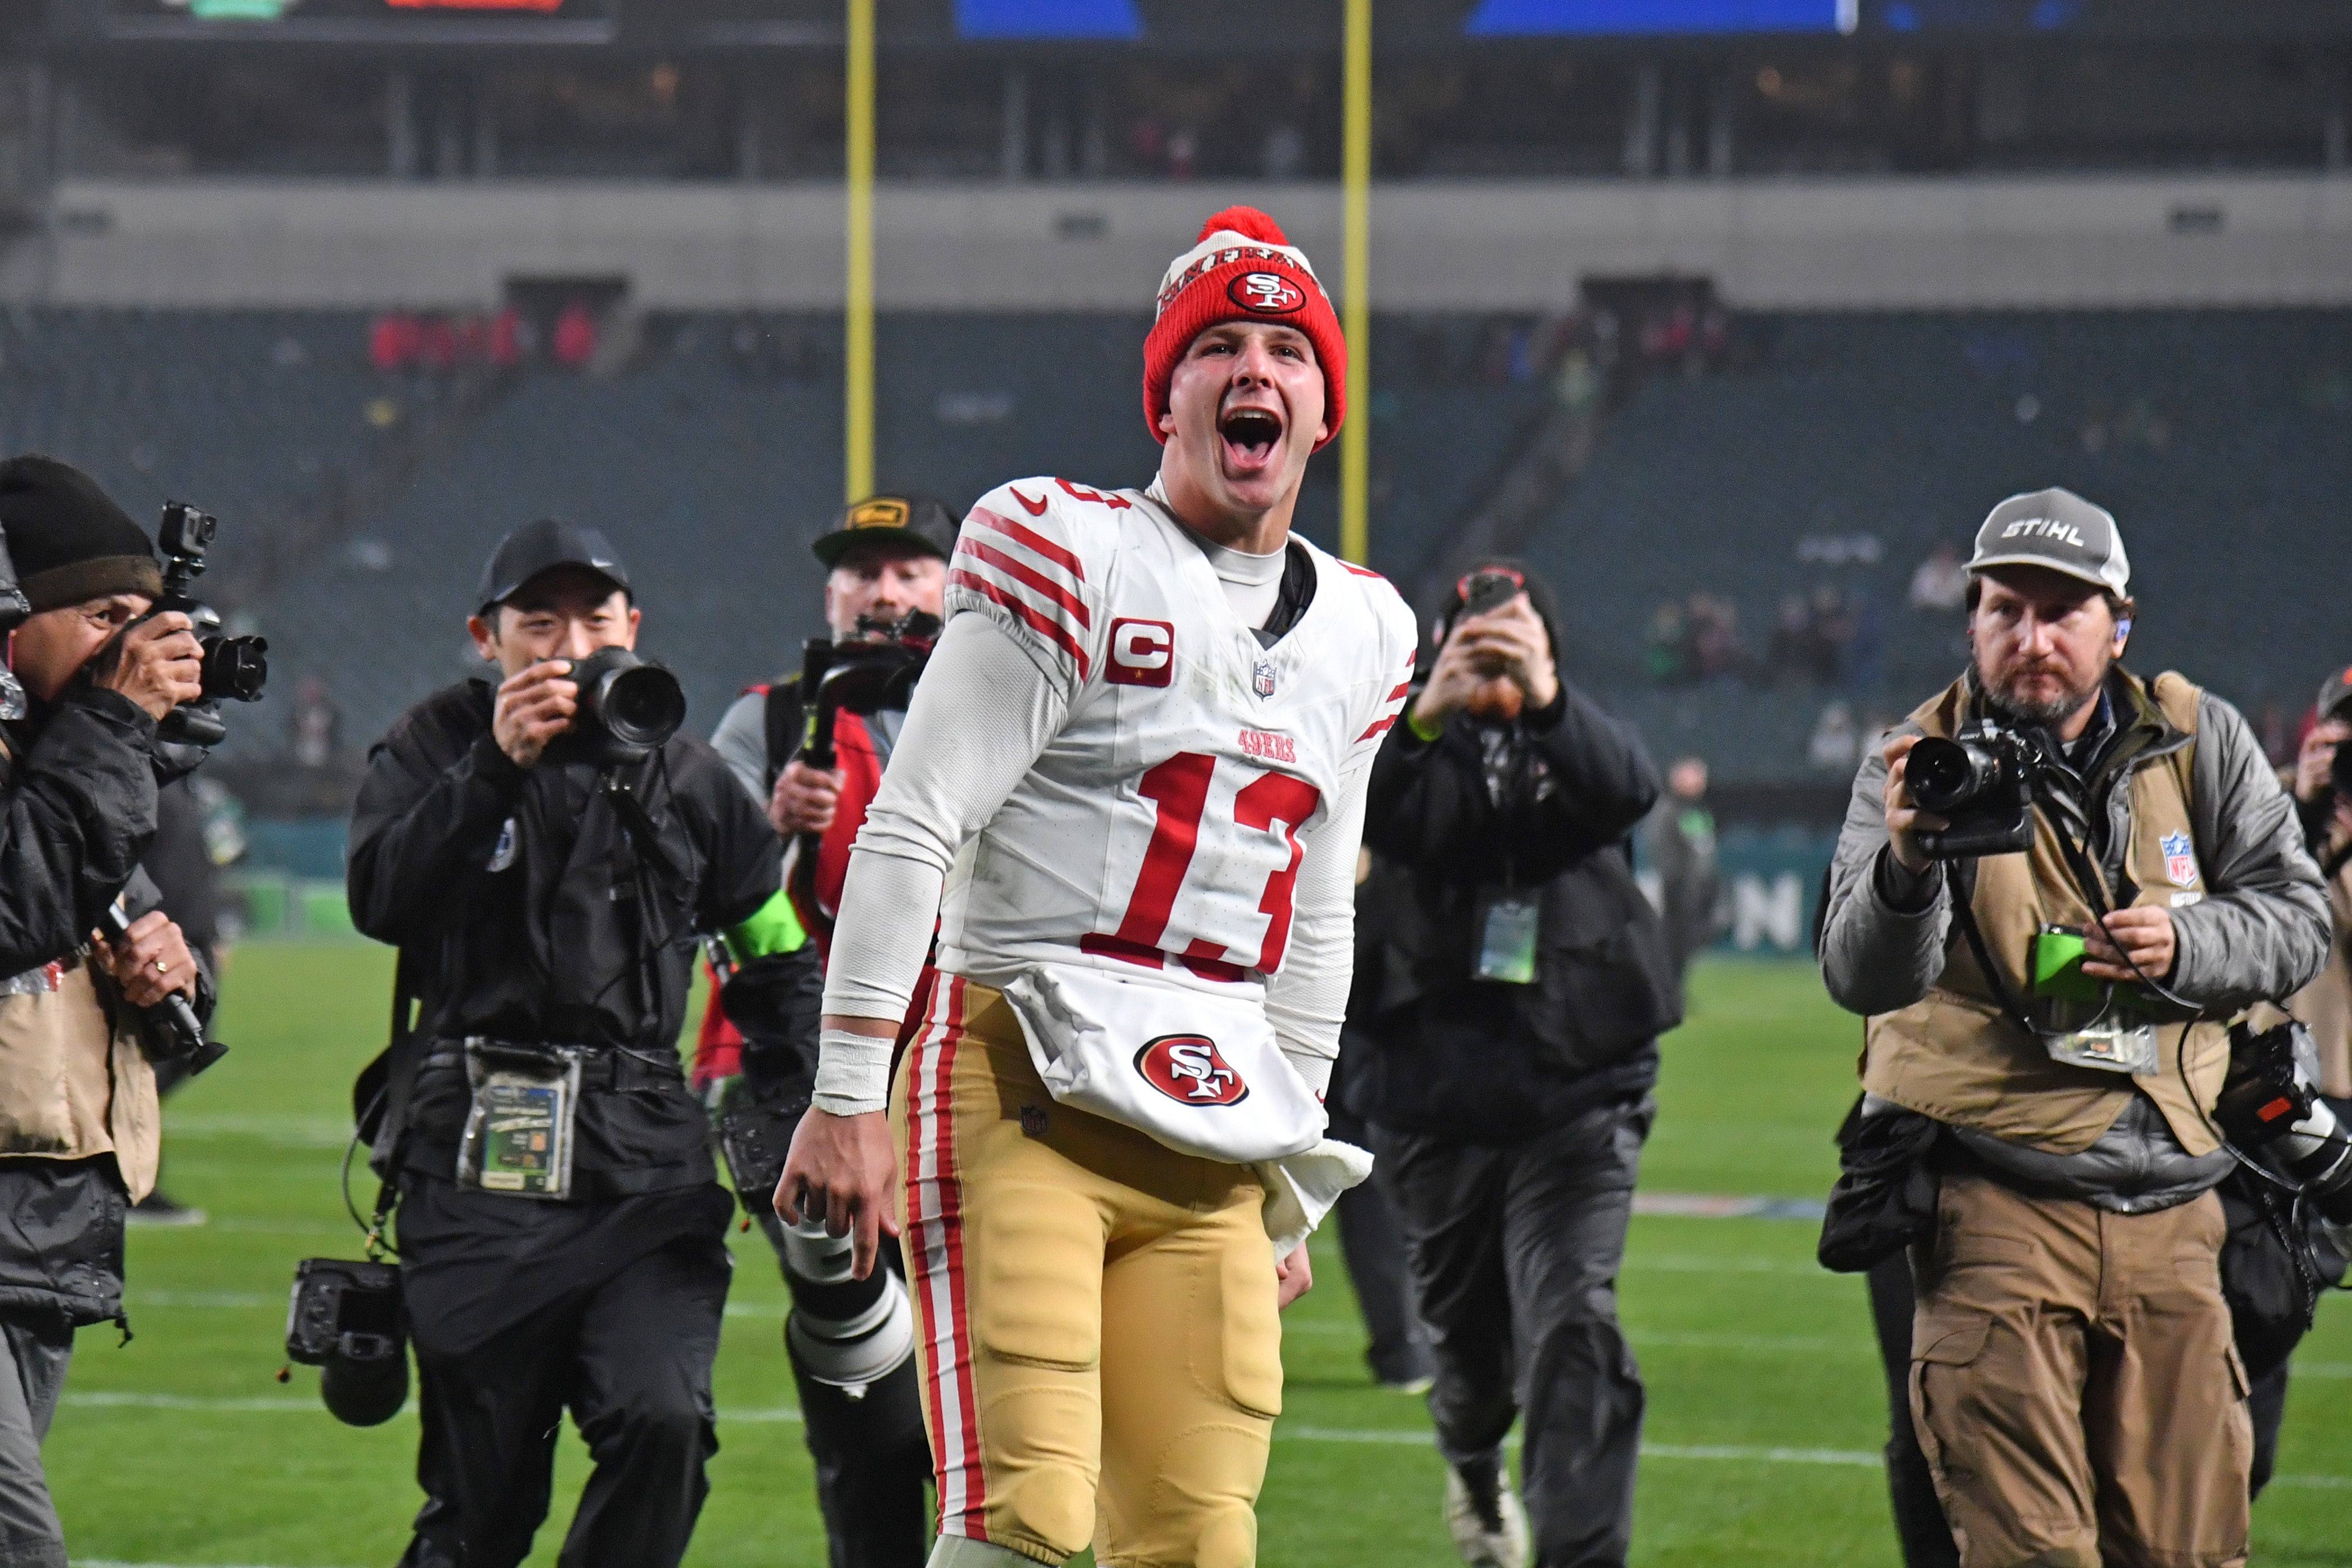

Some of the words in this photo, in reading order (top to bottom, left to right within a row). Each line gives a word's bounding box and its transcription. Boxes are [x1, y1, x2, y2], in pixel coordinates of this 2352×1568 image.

[1246, 274, 1297, 308] SF
[2000, 517, 2085, 547] STIHL
[1113, 622, 1170, 669] C
[1257, 676, 1274, 694] NFL
[1238, 729, 1297, 764] 49ERS
[1079, 751, 1321, 983] 13
[2168, 856, 2195, 882] NFL
[1168, 1045, 1234, 1098] SF
